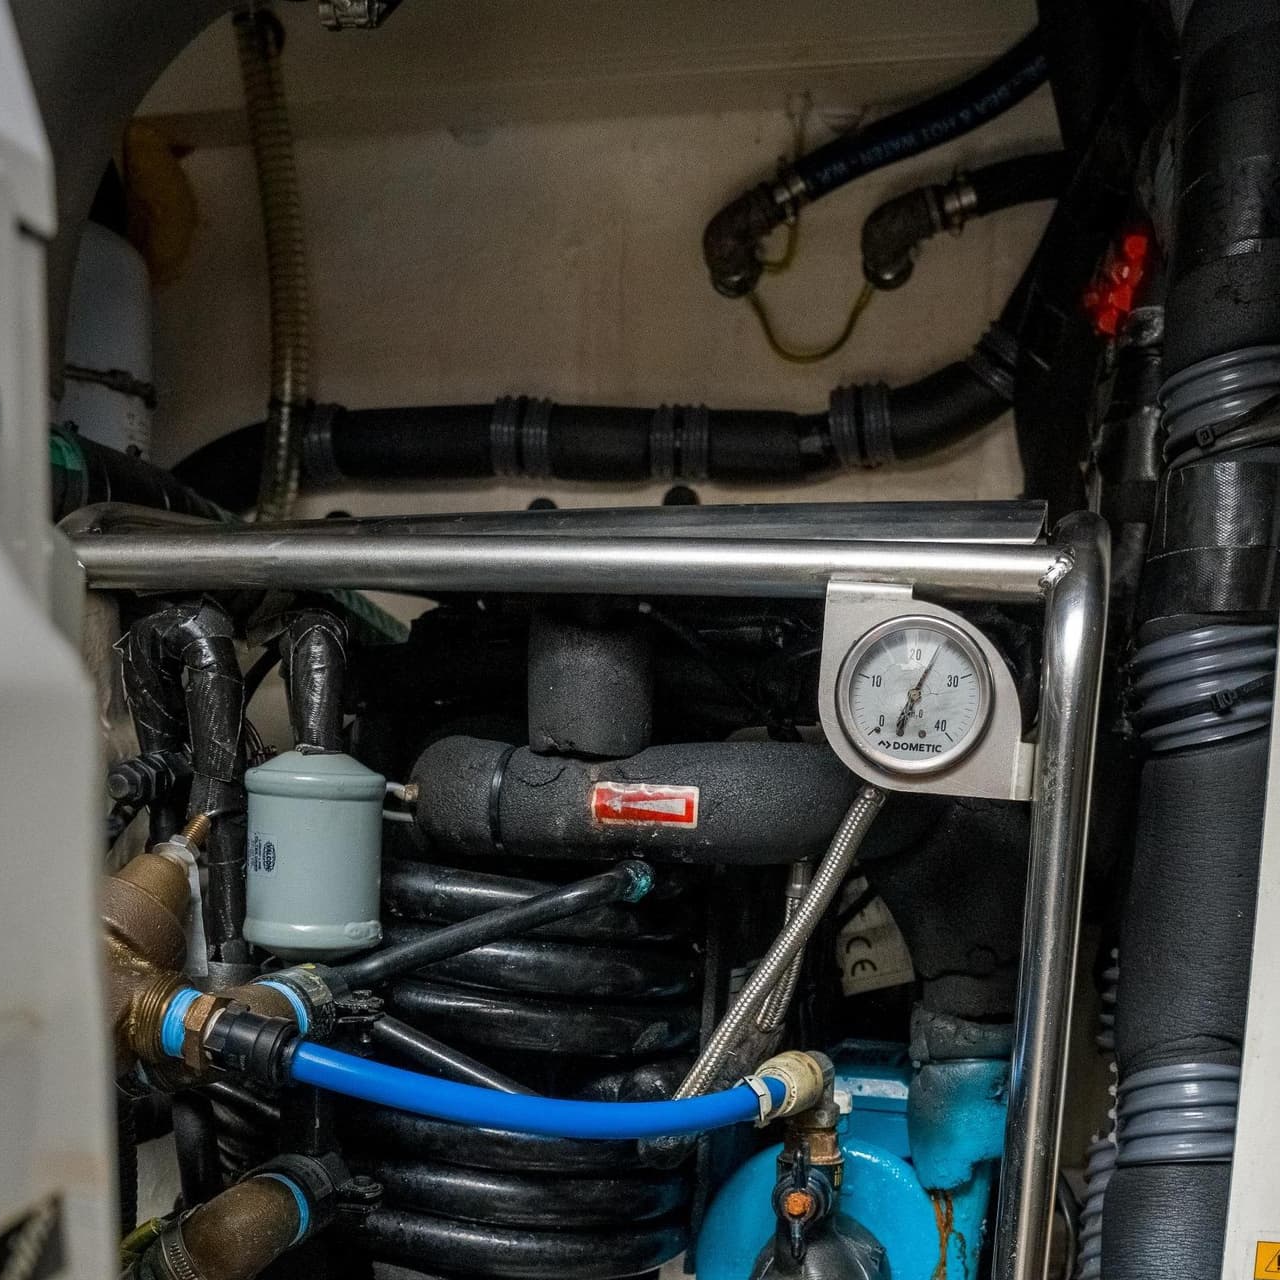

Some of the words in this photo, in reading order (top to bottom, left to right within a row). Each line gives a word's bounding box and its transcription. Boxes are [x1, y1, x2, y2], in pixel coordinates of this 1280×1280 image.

[909, 649, 922, 661] 20
[871, 675, 882, 687] 10
[947, 675, 959, 688] 30
[879, 714, 885, 727] 0
[934, 719, 947, 732] 40
[892, 741, 943, 753] DOMETIC
[846, 936, 877, 976] CE
